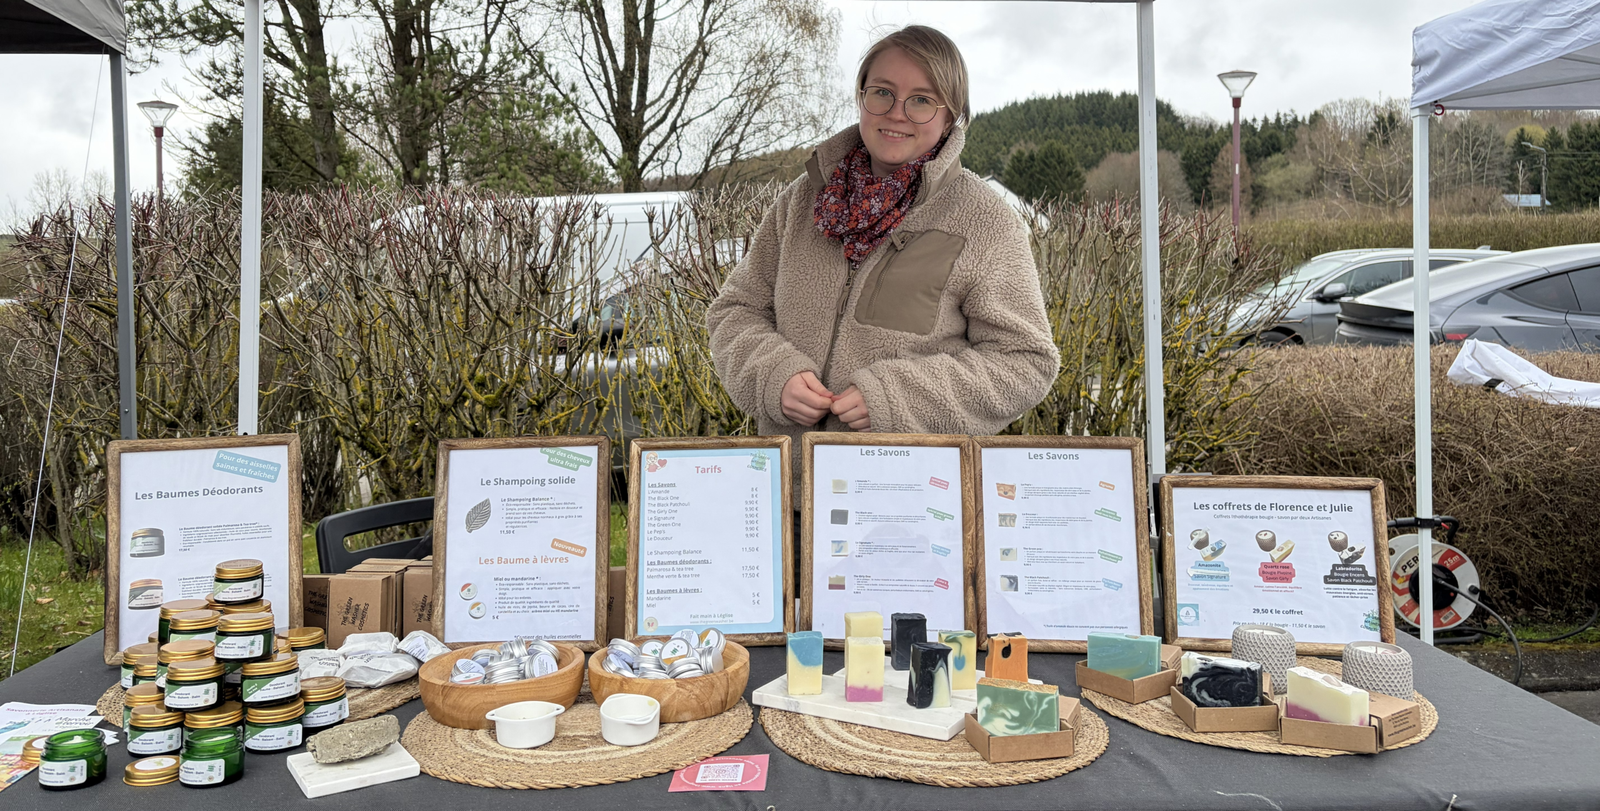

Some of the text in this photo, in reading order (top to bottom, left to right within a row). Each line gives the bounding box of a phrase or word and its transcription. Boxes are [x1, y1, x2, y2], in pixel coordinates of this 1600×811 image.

[557, 450, 566, 458] des
[567, 453, 590, 464] cheveux
[878, 448, 910, 456] Savons
[1046, 452, 1079, 460] Savons
[219, 453, 278, 472] Pour des aisselles
[550, 457, 577, 469] ultra frais
[216, 462, 238, 472] saines
[247, 468, 275, 480] fraîches
[695, 465, 722, 474] Tarifs
[494, 477, 546, 487] Shampoing
[548, 476, 576, 485] solide
[135, 485, 263, 500] Les Baumes Déodorants
[1194, 502, 1210, 510] Les
[1213, 502, 1252, 510] coffrets
[1254, 502, 1267, 511] de
[1270, 503, 1313, 511] Florence
[1330, 503, 1353, 513] Julie
[553, 541, 585, 554] Nouveauté
[497, 556, 530, 564] Baume
[532, 556, 538, 564] à
[540, 555, 569, 564] lèvres
[1401, 554, 1419, 573] PER
[1444, 554, 1460, 567] 25m
[305, 607, 326, 616] COSMETIC
[351, 604, 361, 625] WASHER
[358, 603, 369, 631] COSMETICS
